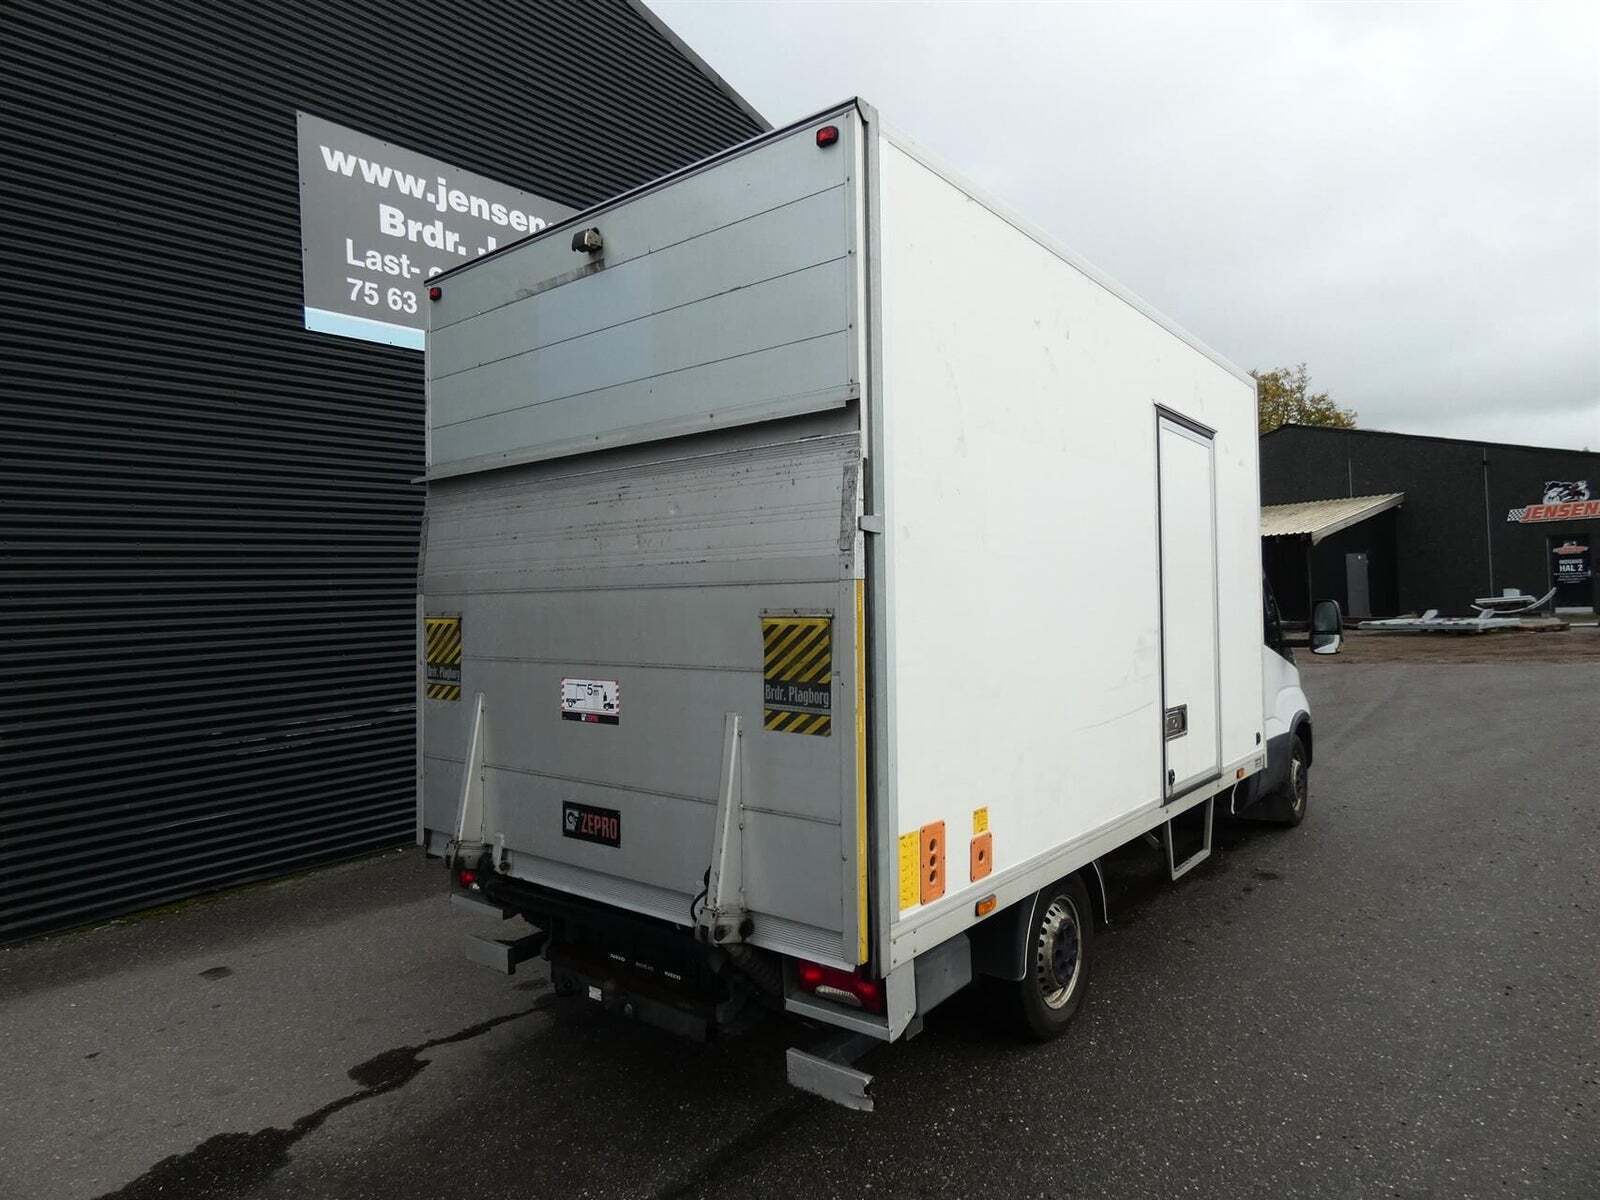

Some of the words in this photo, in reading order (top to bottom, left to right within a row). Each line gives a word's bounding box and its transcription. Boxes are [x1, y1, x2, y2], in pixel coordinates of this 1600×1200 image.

[319, 144, 555, 234] www.jensen
[379, 203, 467, 256] Brdr.
[346, 238, 421, 279] Last-
[346, 277, 379, 306] 75
[387, 287, 418, 314] 63
[1523, 502, 1600, 520] JENSEN
[1559, 564, 1576, 572] HAL
[586, 683, 593, 696] 5
[764, 684, 787, 701] Brdr.
[581, 812, 618, 840] ZEPRO
